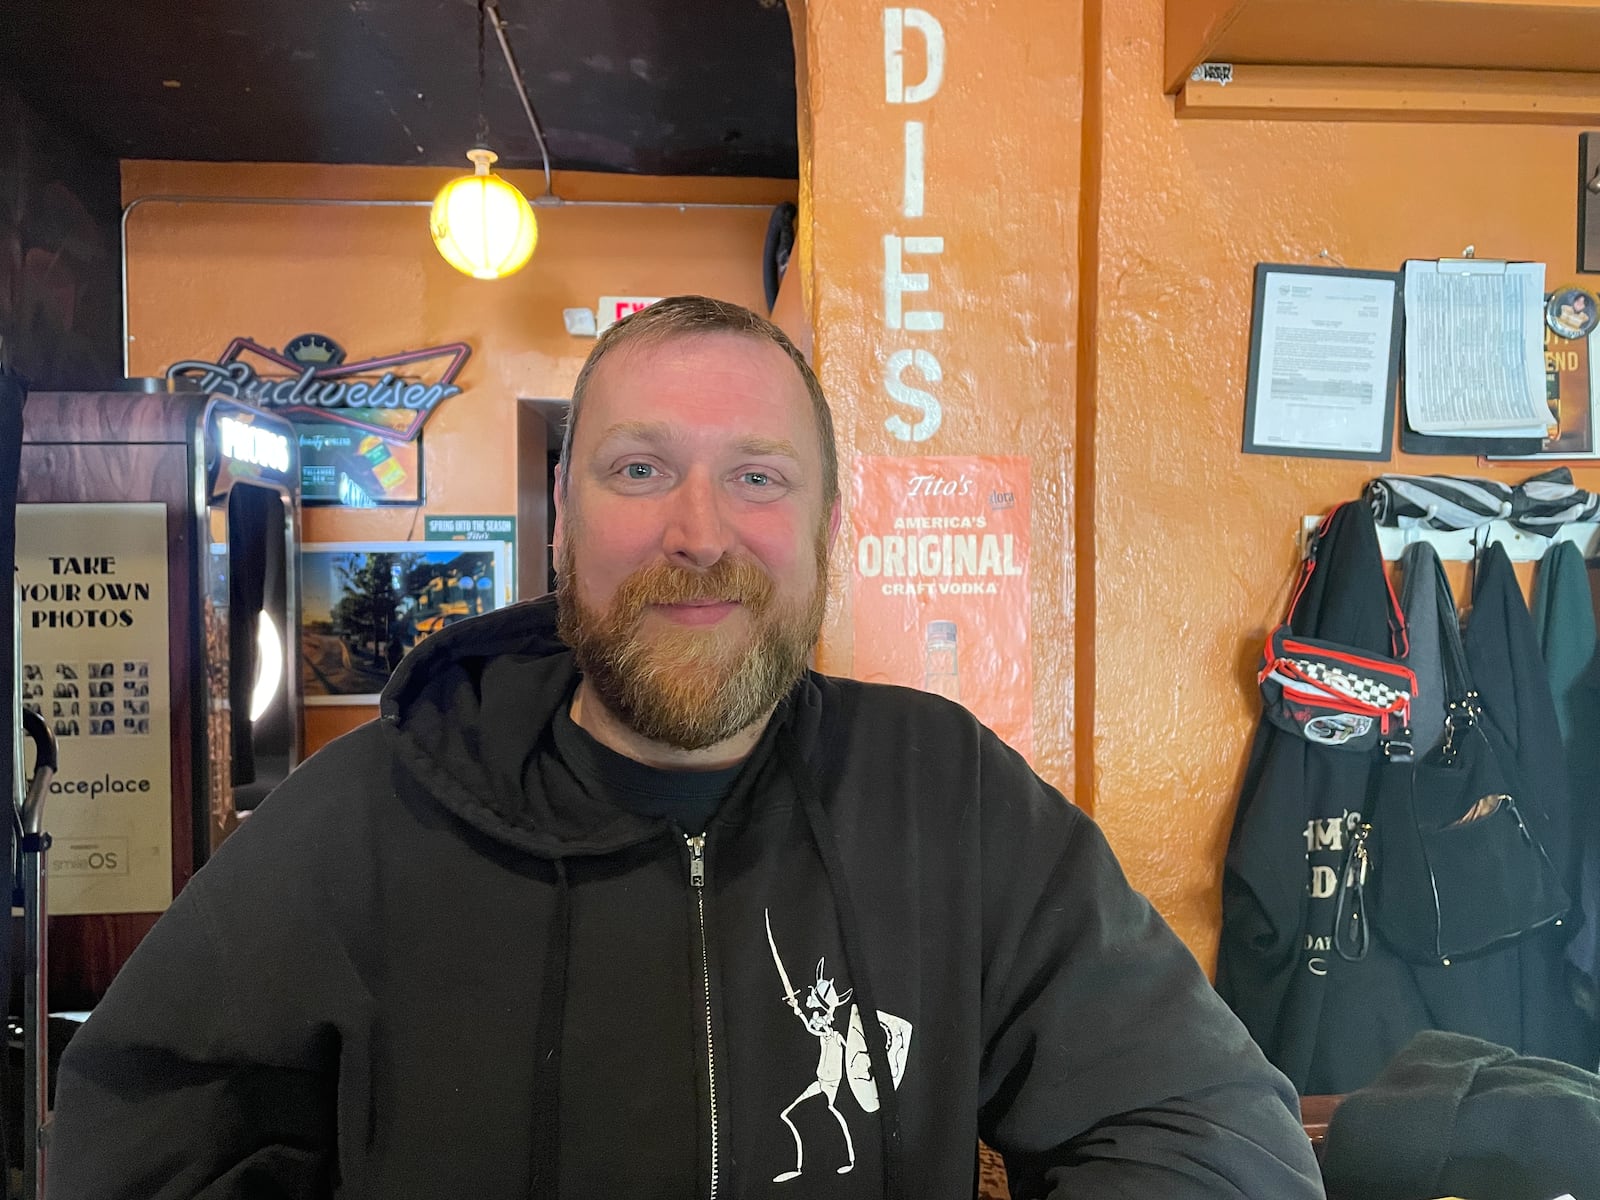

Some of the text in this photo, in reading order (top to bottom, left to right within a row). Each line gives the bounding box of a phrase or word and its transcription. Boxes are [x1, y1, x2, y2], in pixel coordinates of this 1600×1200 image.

[167, 360, 461, 409] Budweiser
[906, 473, 974, 497] Tito's
[429, 520, 511, 532] SPRING INTO THE SEASON
[894, 516, 987, 529] AMERICA'S
[858, 533, 1023, 577] ORIGINAL
[48, 556, 116, 575] TAKE
[21, 582, 150, 602] YOUR OWN
[881, 582, 997, 596] CRAFT VODKA
[32, 609, 134, 628] PHOTOS
[26, 773, 151, 800] aceplace
